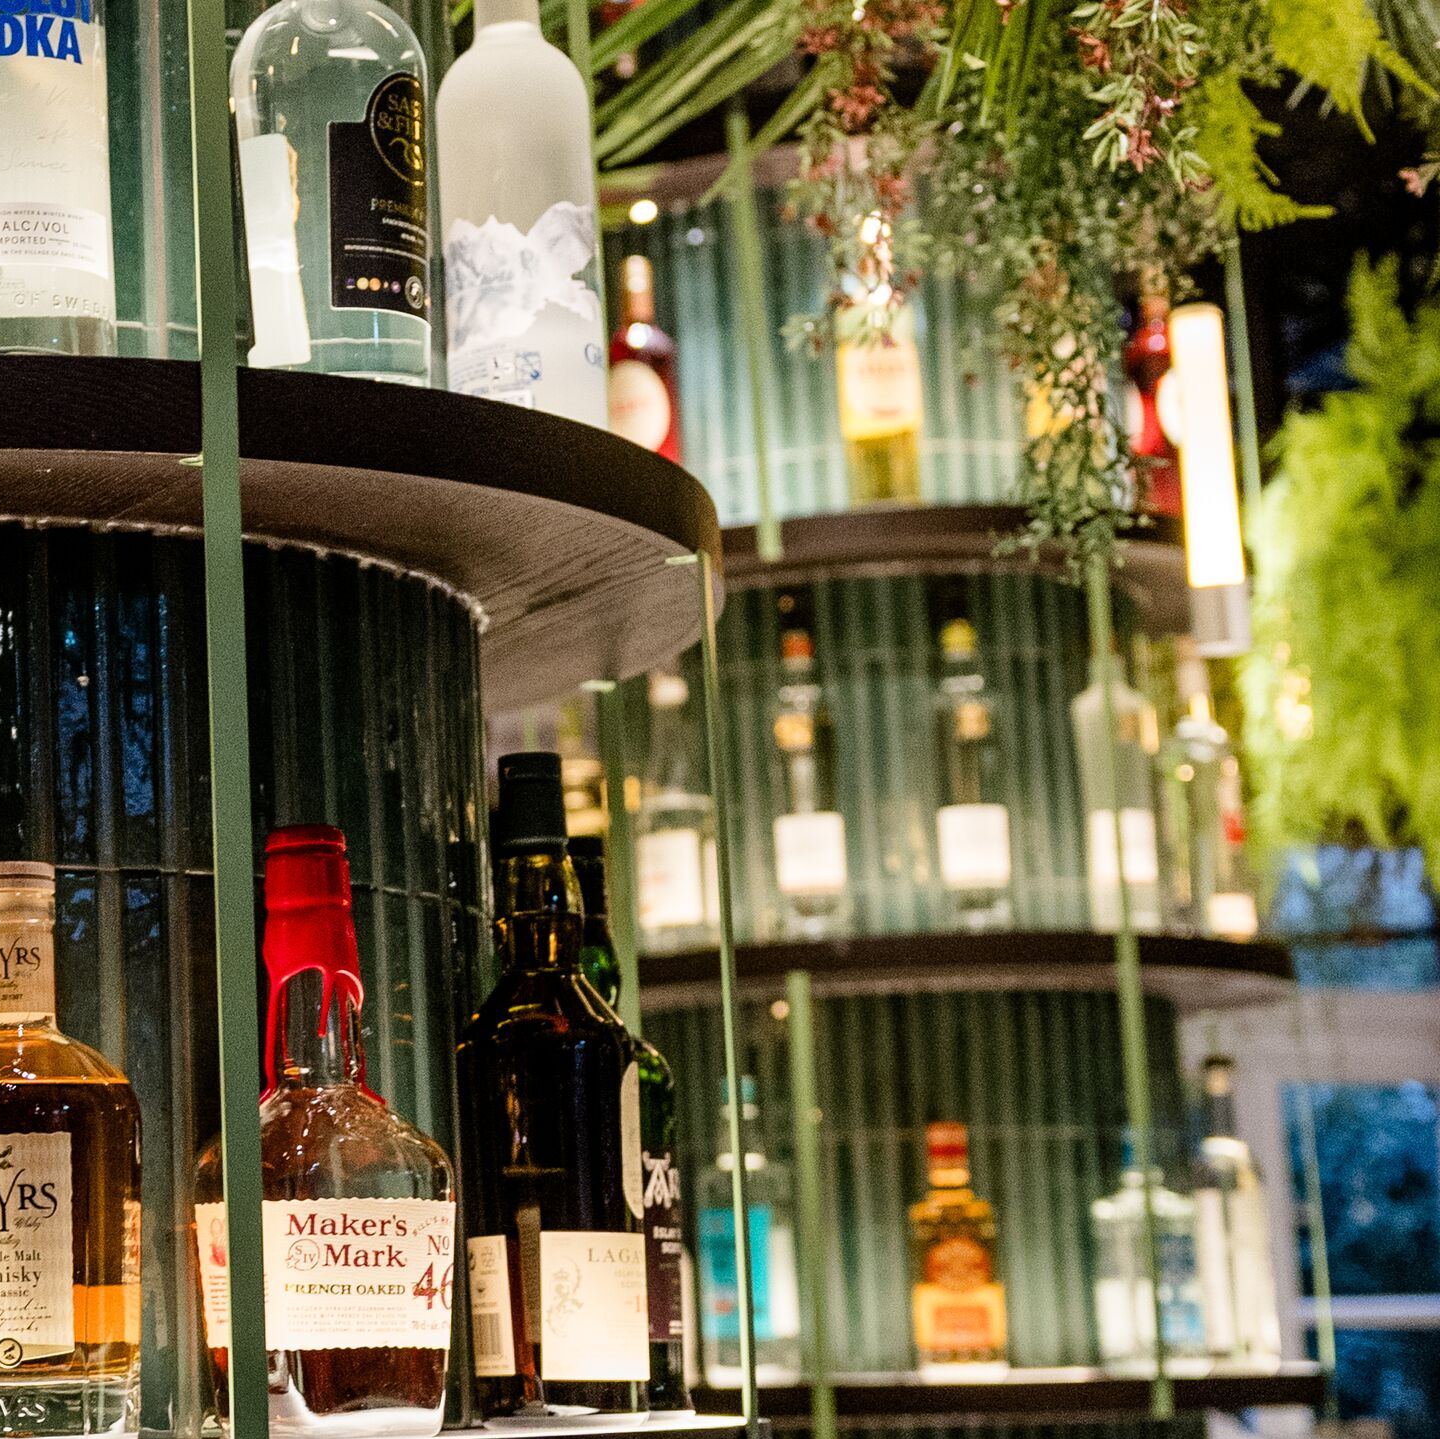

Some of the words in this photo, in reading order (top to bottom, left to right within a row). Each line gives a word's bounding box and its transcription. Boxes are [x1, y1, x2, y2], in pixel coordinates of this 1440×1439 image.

[2, 219, 70, 236] ALC/VOL
[13, 293, 41, 306] OF
[285, 1213, 408, 1237] Maker's
[14, 1250, 42, 1261] Malt
[322, 1243, 406, 1268] Mark
[284, 1283, 352, 1295] FRENCH
[356, 1283, 406, 1295] OAKED
